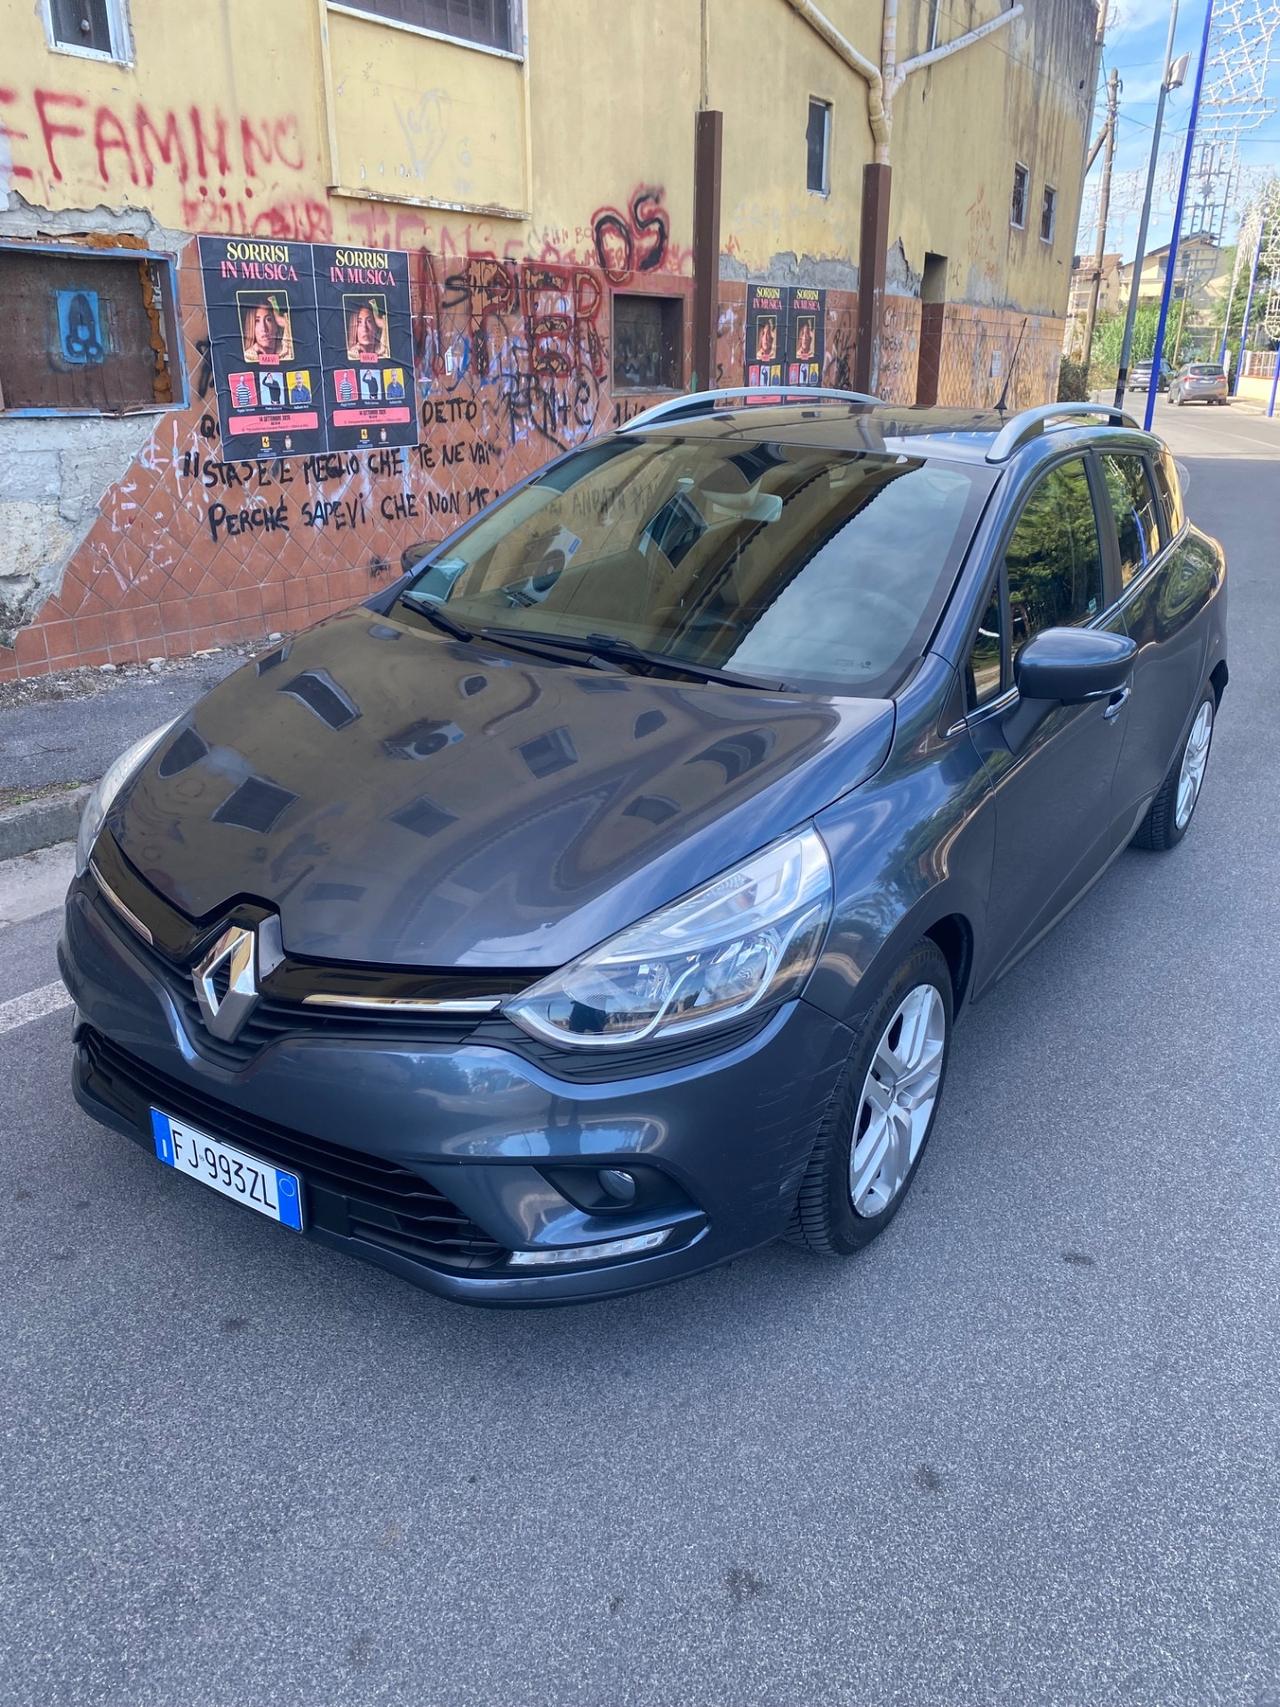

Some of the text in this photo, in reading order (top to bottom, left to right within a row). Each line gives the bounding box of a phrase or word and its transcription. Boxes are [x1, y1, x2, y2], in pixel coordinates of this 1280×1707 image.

[226, 241, 290, 263] SORRISI
[335, 249, 389, 270] SORRISI
[220, 260, 299, 282] IN MUSICA
[330, 266, 396, 287] IN MUSICA
[422, 397, 477, 427] DETTO
[368, 450, 405, 477] CHE
[412, 443, 436, 469] TE
[442, 441, 466, 467] NE
[301, 493, 366, 531] SAPEVI
[380, 492, 419, 521] CHE
[428, 490, 461, 515] NON
[171, 1129, 277, 1210] FJ993ZL
